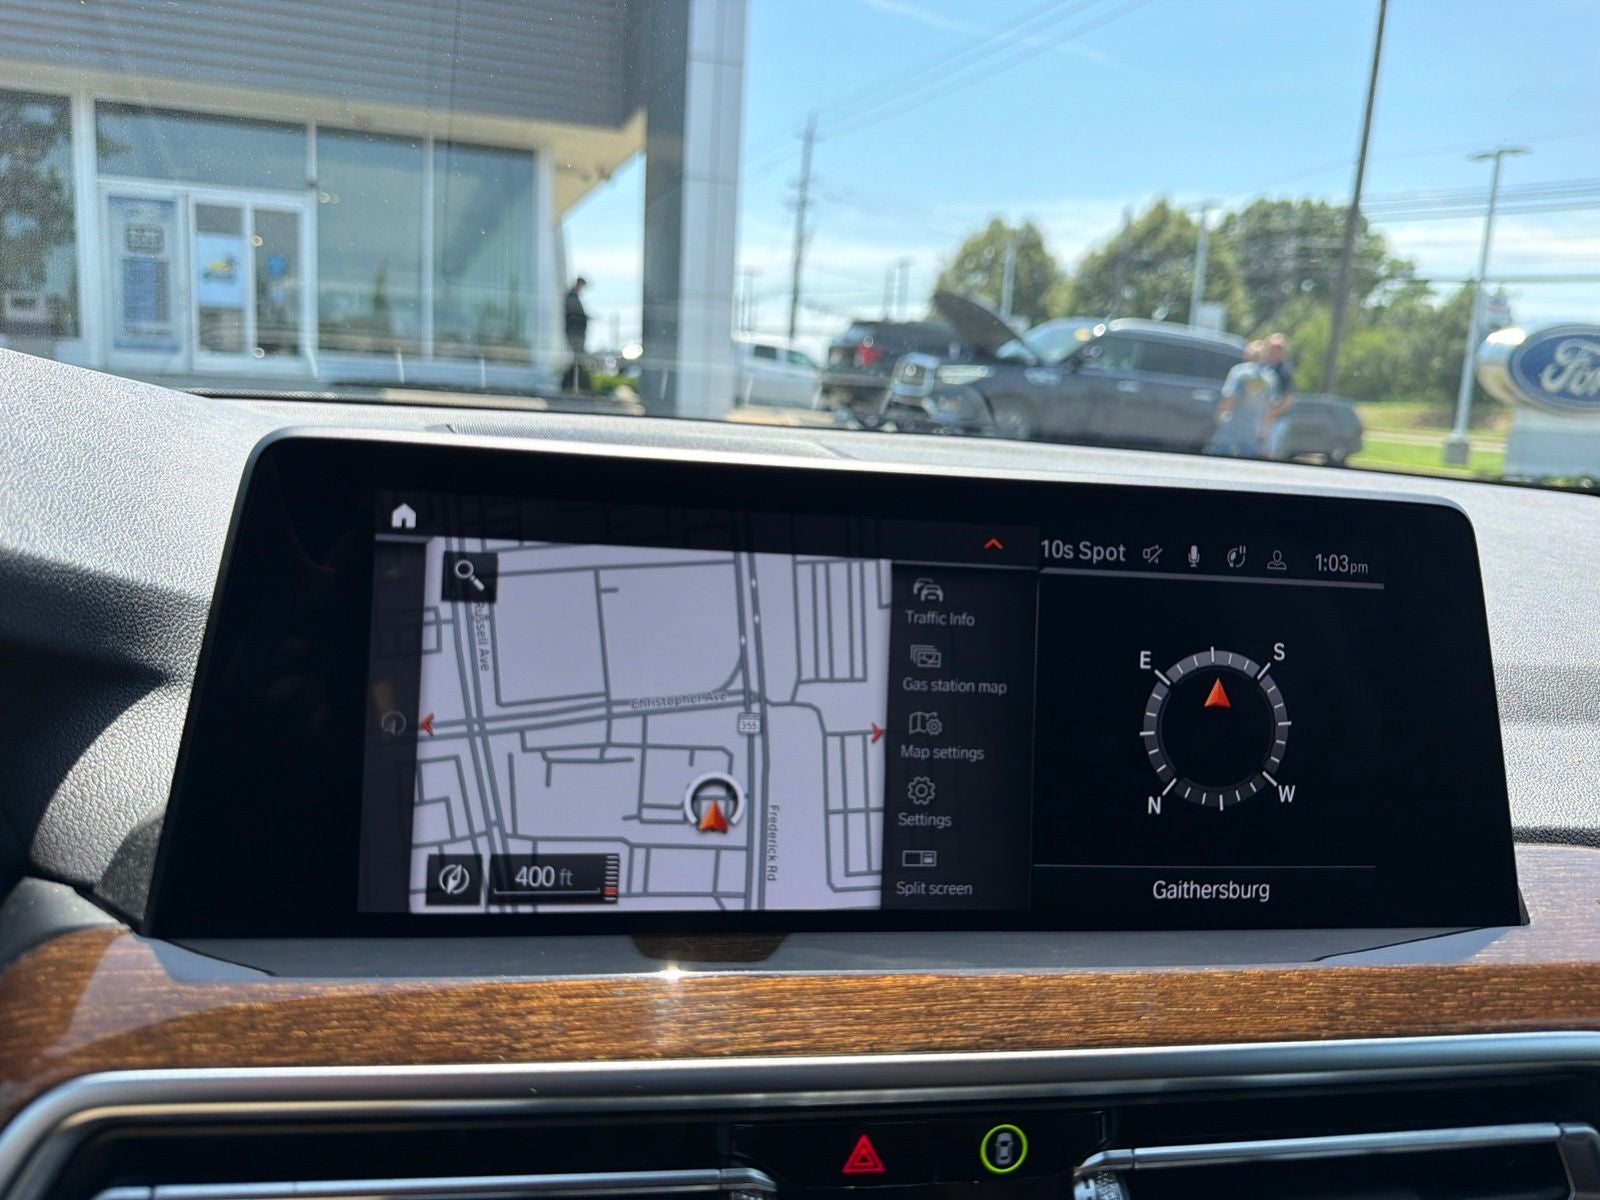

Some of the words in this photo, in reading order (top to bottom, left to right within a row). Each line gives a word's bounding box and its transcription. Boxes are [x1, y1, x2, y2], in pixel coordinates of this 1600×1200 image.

[1539, 338, 1600, 396] For
[1040, 539, 1074, 559] 10s
[1078, 541, 1126, 564] Spot
[905, 609, 947, 626] Traffic
[949, 612, 976, 627] Info
[479, 647, 491, 672] Ave
[1139, 650, 1152, 670] E
[1272, 642, 1286, 661] S
[902, 677, 929, 693] Gas
[930, 678, 975, 694] station
[978, 684, 1008, 696] map
[631, 692, 703, 709] Christopher
[705, 689, 729, 702] Ave
[740, 721, 758, 730] 355
[900, 744, 931, 760] Map
[932, 746, 985, 762] settings
[1278, 784, 1296, 803] W
[1147, 796, 1162, 815] N
[898, 812, 953, 829] Settings
[767, 804, 780, 862] Frederick
[514, 865, 556, 887] 400
[559, 867, 574, 887] ft
[767, 865, 779, 882] Rd
[896, 881, 927, 897] Split
[929, 882, 974, 896] screen
[1152, 879, 1271, 903] Gaithersburg
